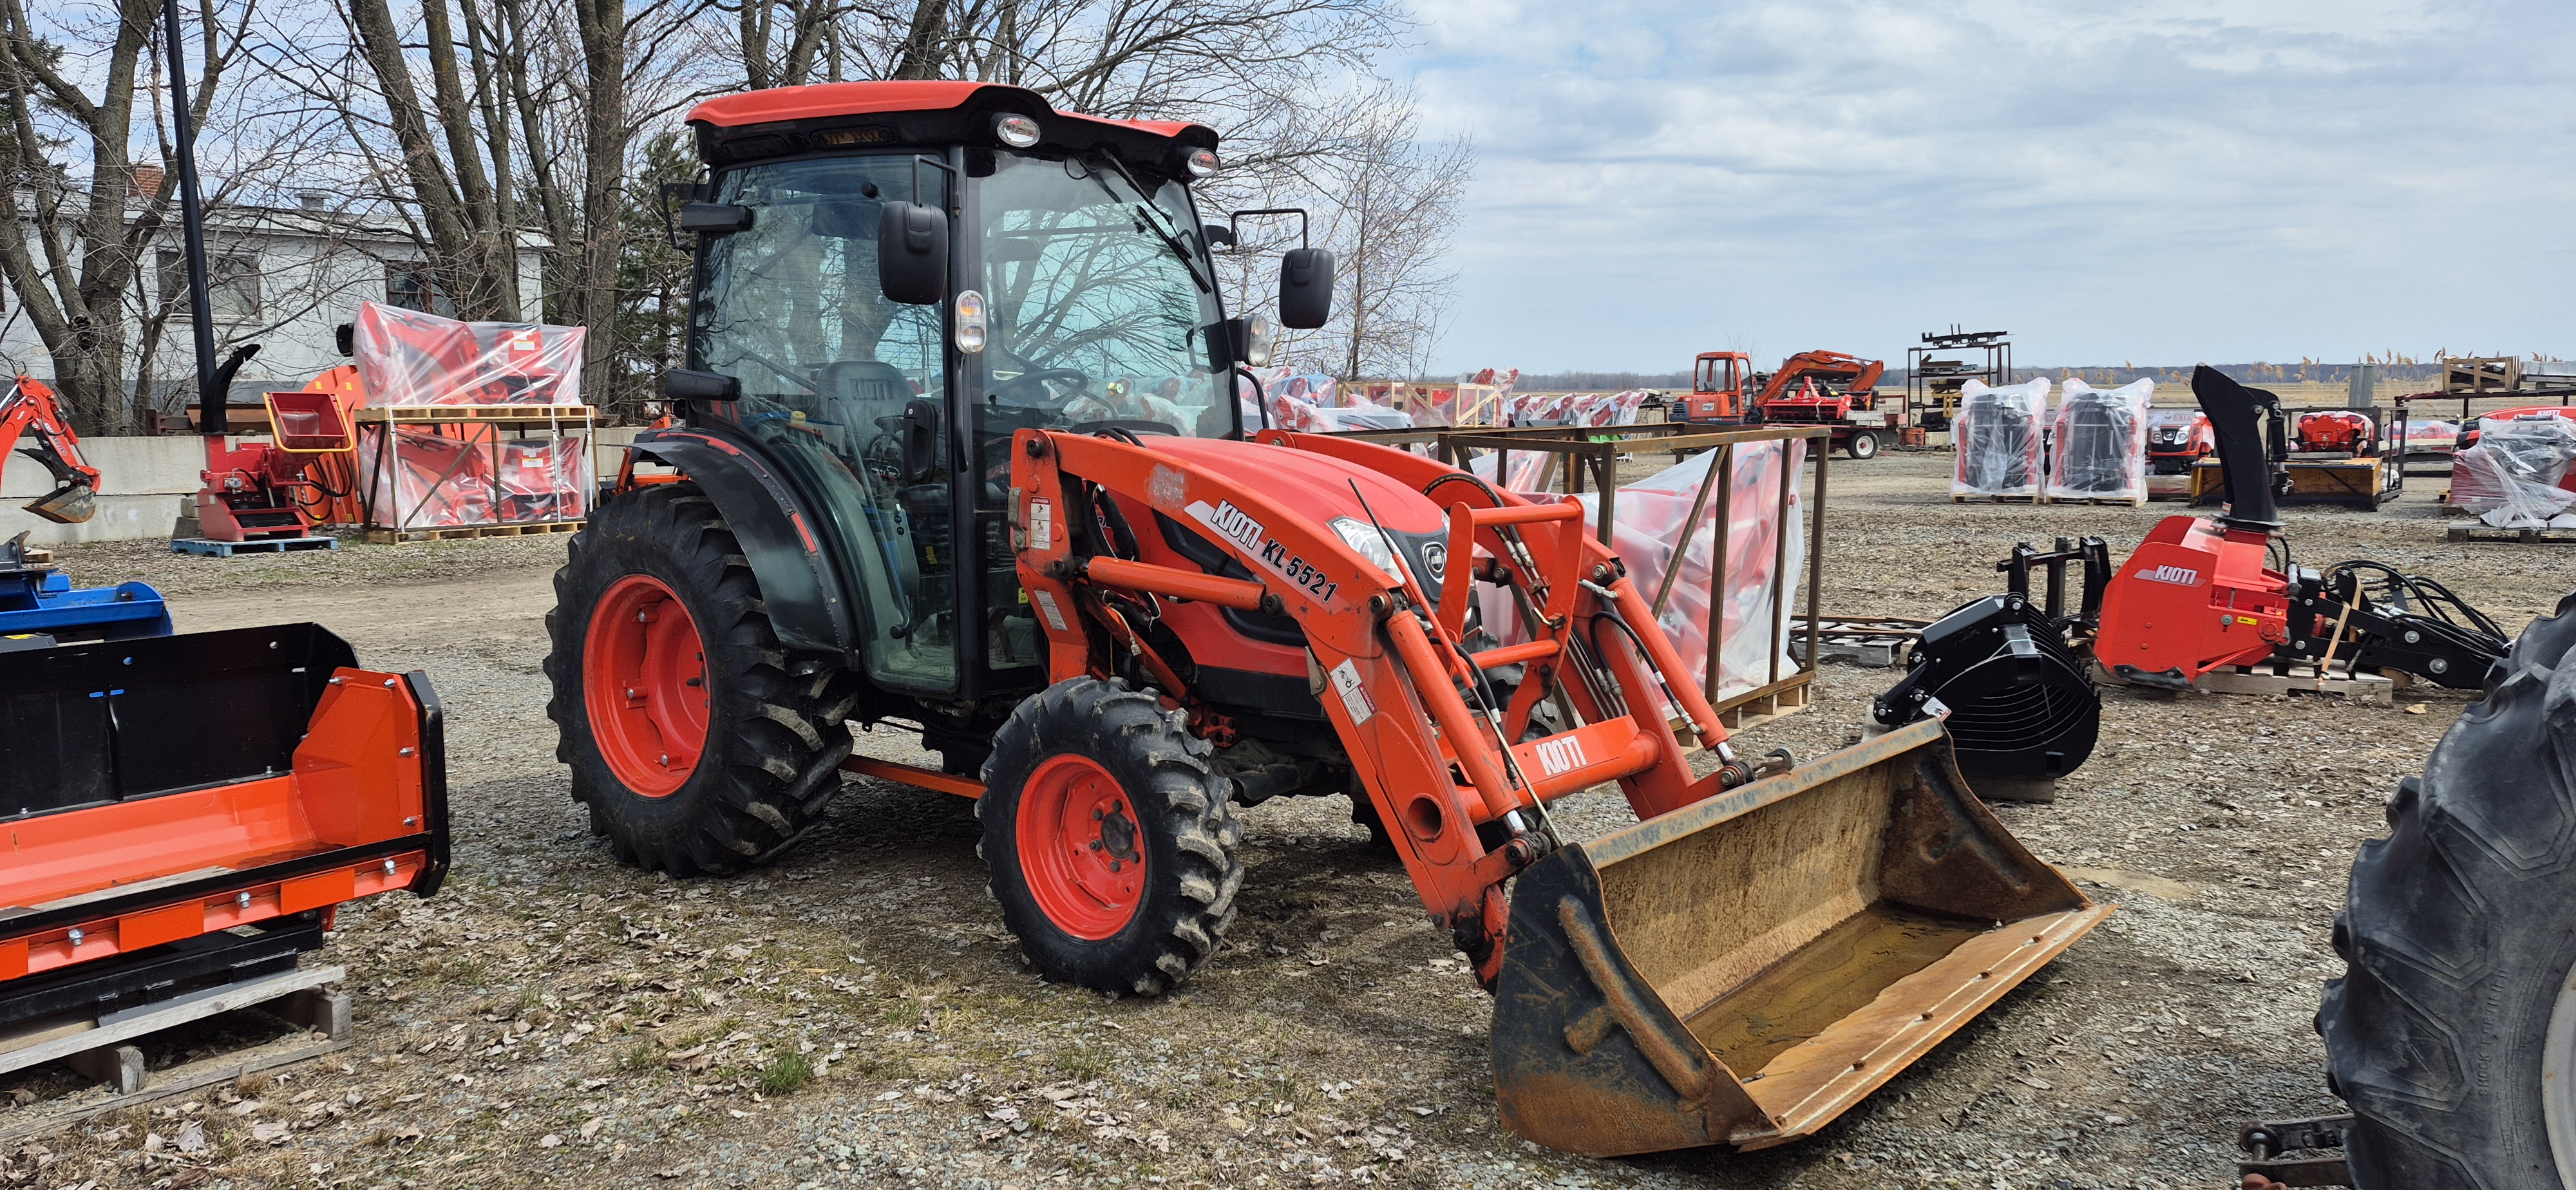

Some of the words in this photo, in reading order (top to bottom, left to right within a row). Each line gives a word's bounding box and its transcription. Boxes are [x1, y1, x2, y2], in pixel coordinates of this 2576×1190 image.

[1211, 498, 1265, 550] KIOTI
[2154, 565, 2198, 585] KIOTI
[1535, 735, 1587, 776] KIOTI
